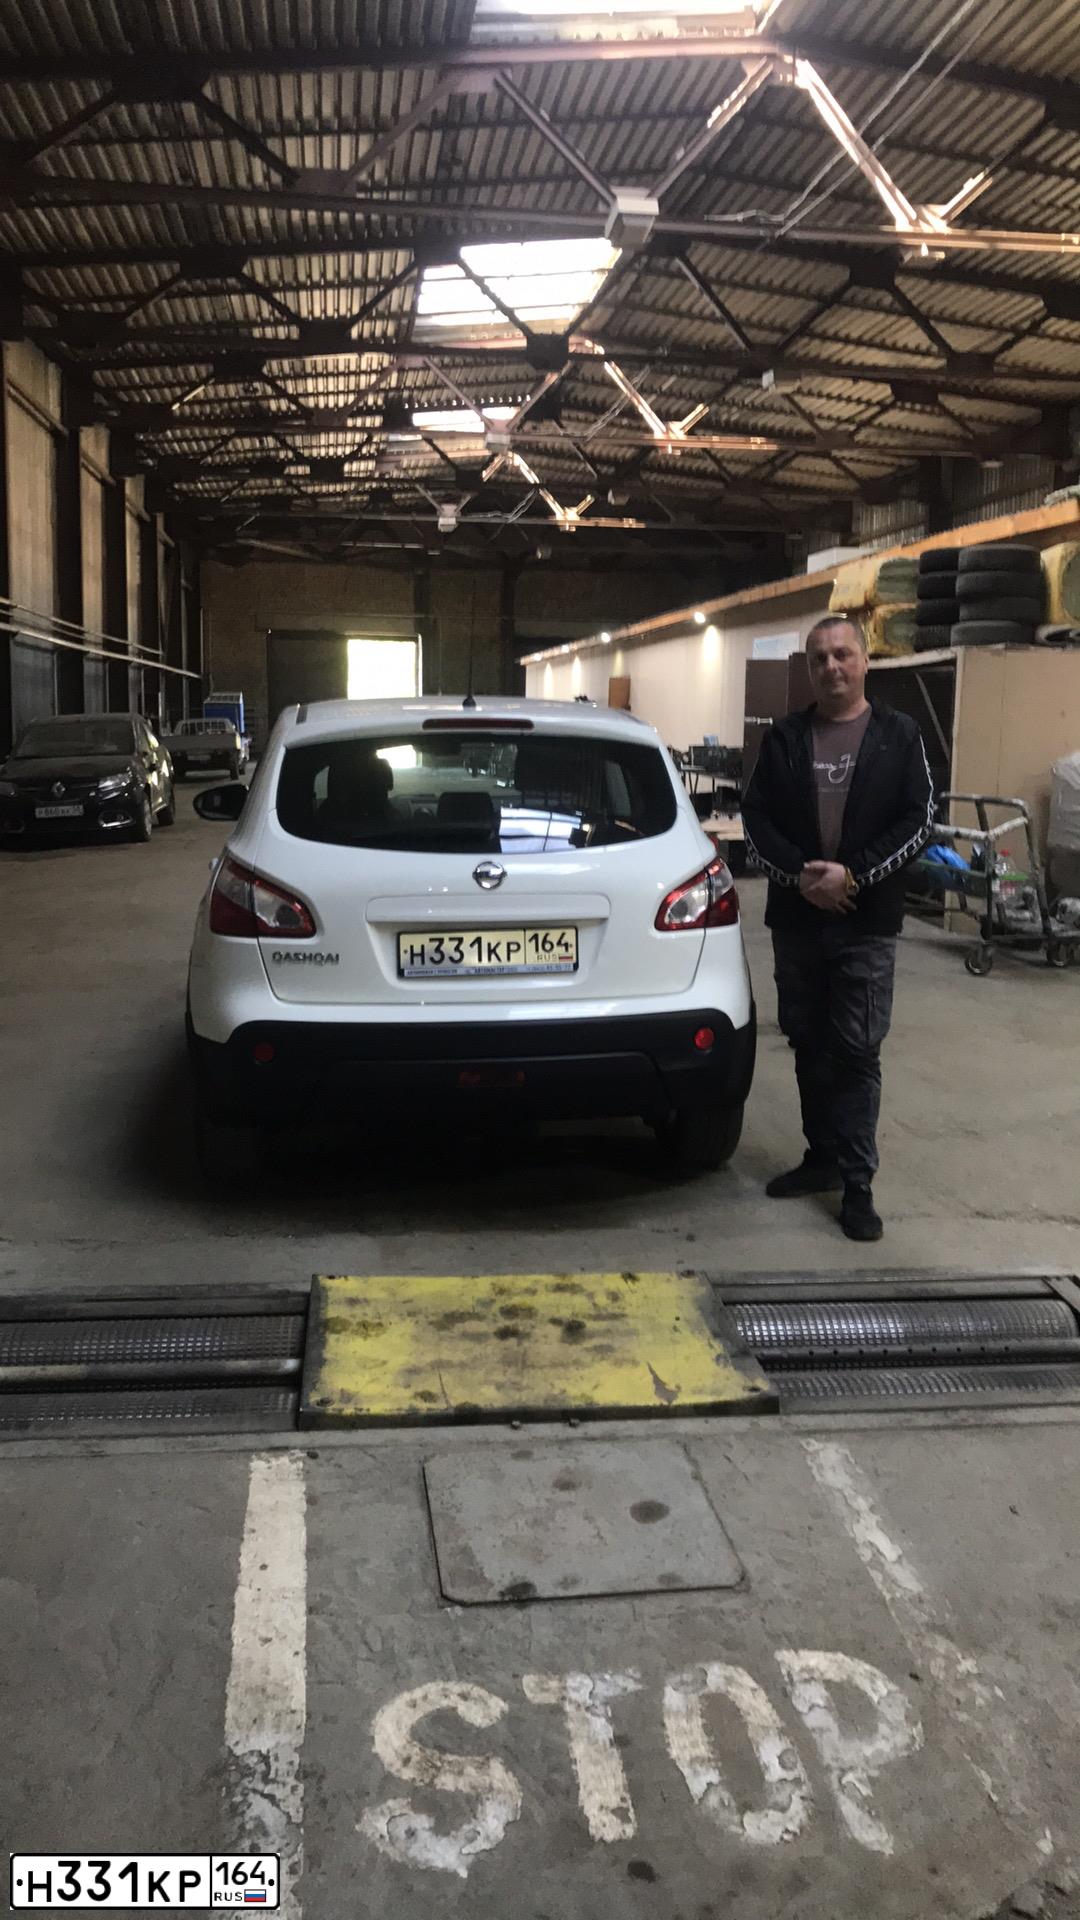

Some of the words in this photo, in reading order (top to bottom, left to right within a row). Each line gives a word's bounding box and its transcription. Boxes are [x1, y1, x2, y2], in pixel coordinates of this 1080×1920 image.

[528, 932, 569, 953] 164
[272, 951, 339, 965] QASHQAI
[355, 1649, 924, 1877] STOP
